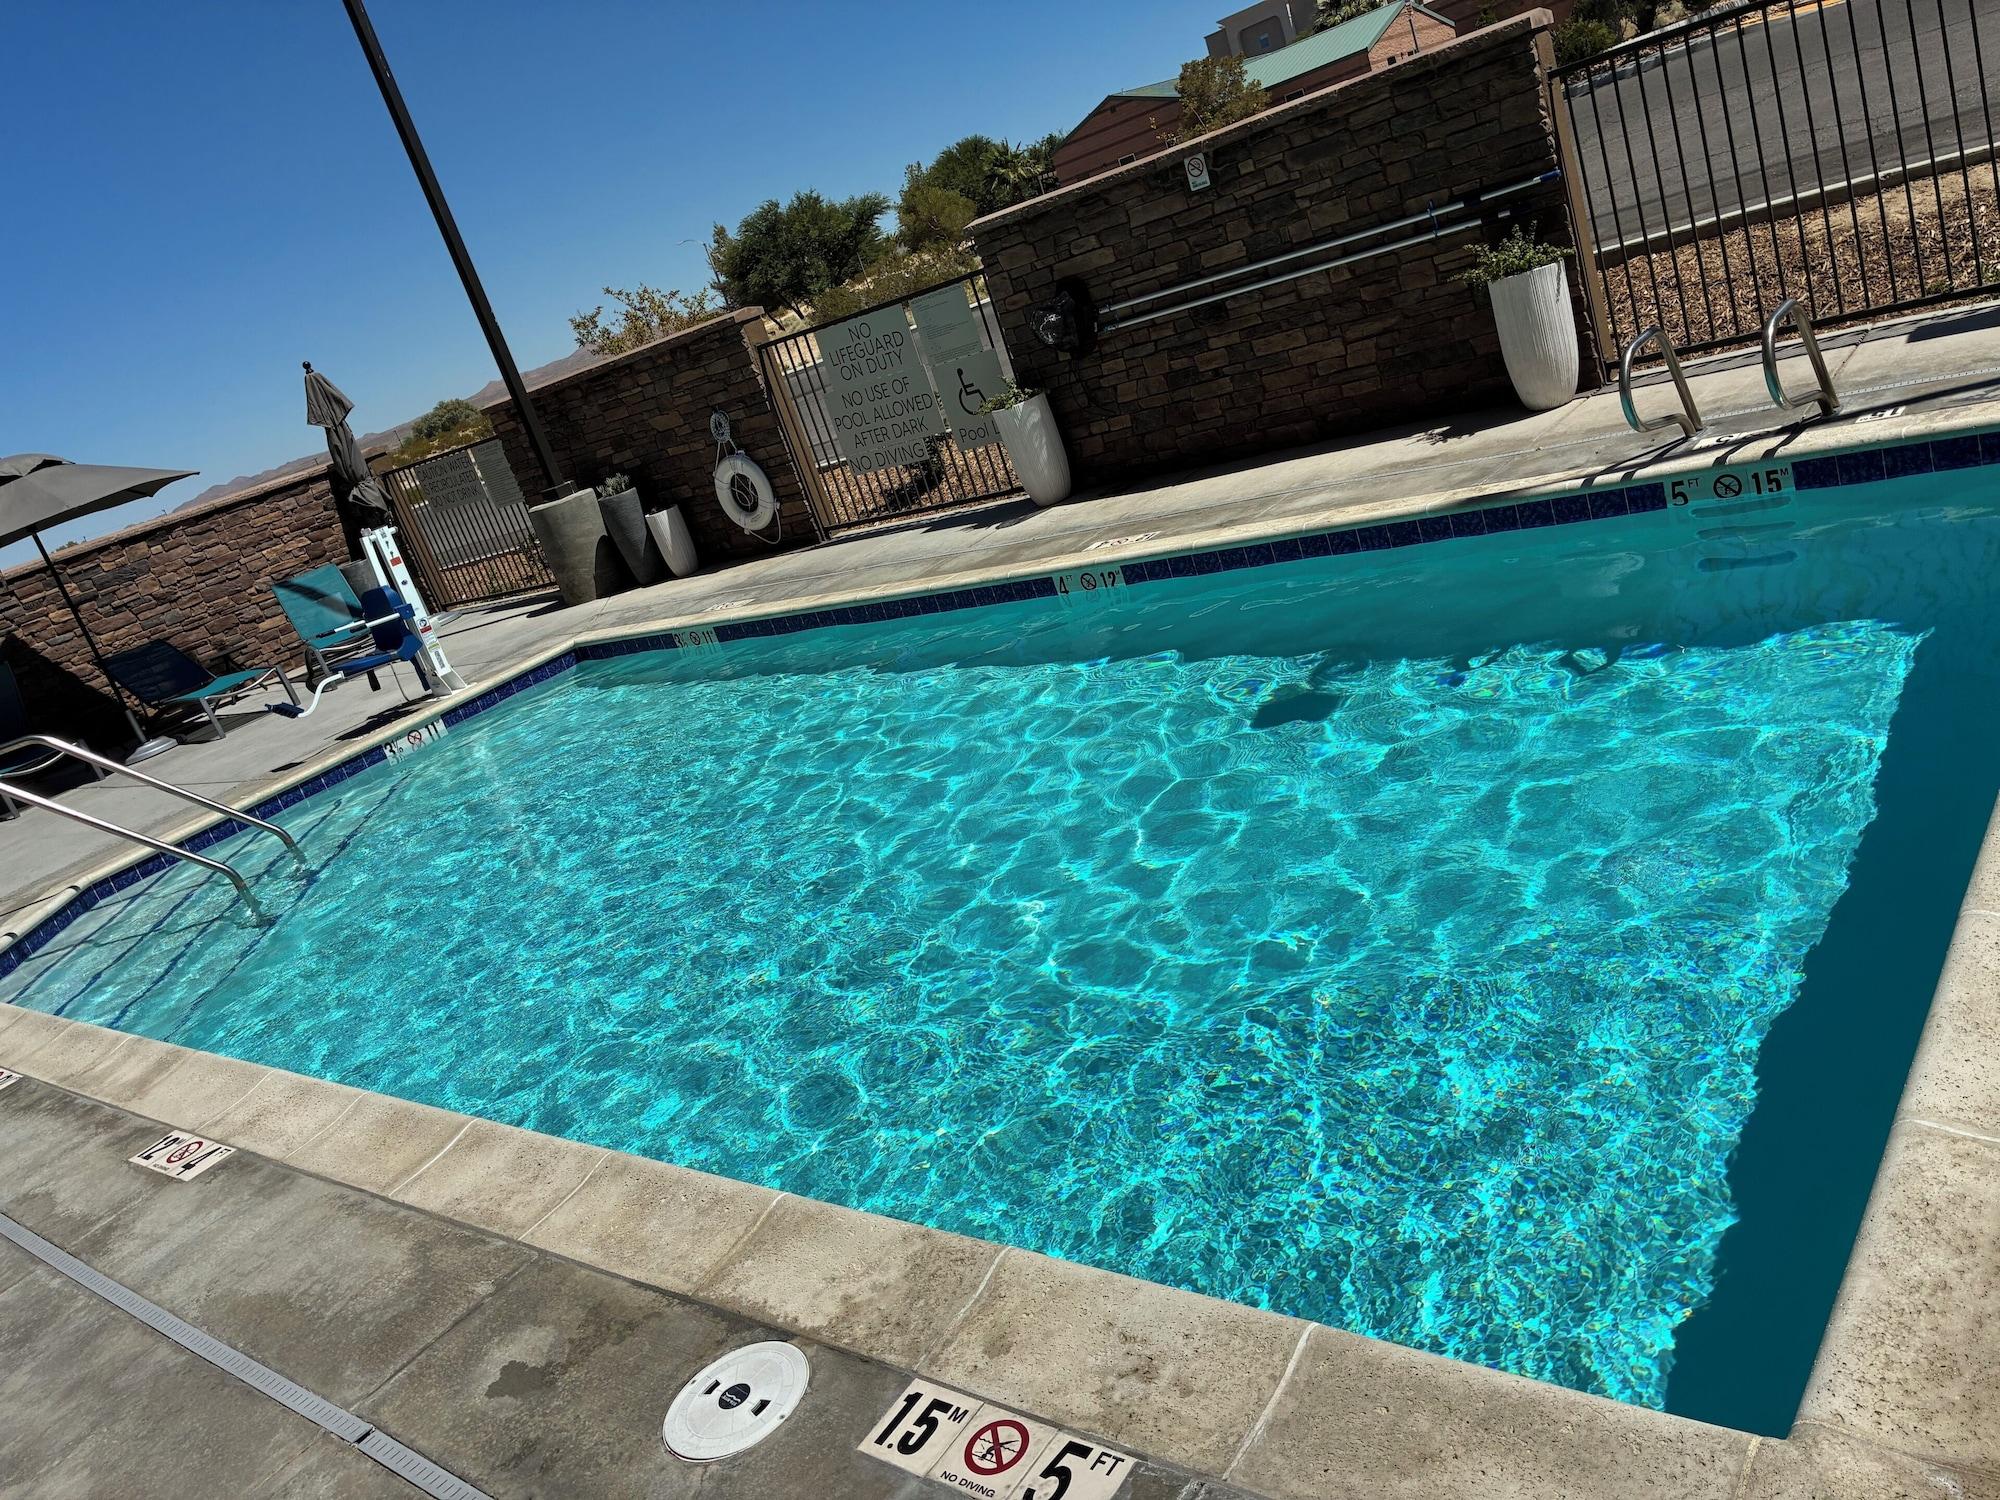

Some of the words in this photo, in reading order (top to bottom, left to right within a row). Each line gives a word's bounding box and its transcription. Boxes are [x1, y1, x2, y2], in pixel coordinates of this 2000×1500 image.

[847, 322, 871, 343] NO
[828, 331, 904, 367] LIFEGUARD
[840, 364, 863, 381] ON
[867, 349, 903, 374] DUTY
[841, 391, 863, 409] NO
[866, 382, 889, 402] USE
[892, 376, 910, 393] OF
[834, 411, 870, 432] POOL
[873, 393, 933, 426] ALLOWED
[854, 427, 889, 448] AFTER
[891, 416, 928, 439] DARK
[959, 422, 989, 443] Pool
[850, 453, 873, 472] NO
[875, 442, 925, 467] DIVING
[940, 1470, 958, 1484] NO
[958, 1478, 996, 1498] DIVING
